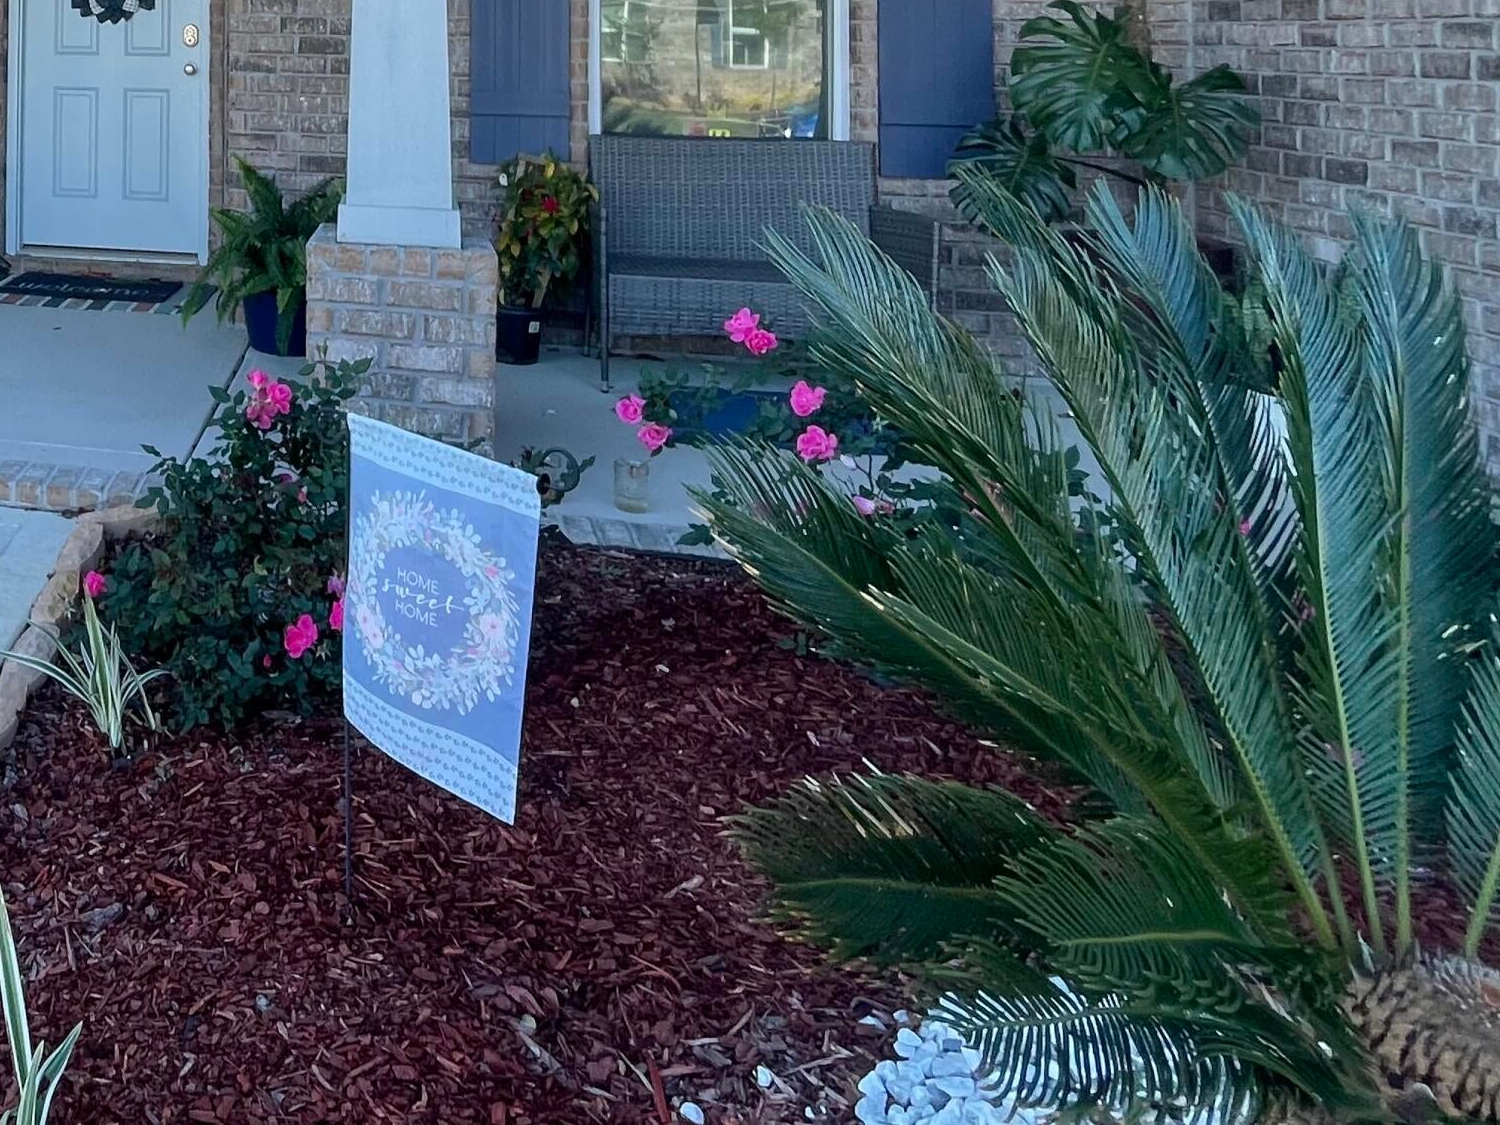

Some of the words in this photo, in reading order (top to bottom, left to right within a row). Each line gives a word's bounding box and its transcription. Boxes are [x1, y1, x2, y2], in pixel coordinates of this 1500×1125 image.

[397, 566, 439, 595] HOME
[381, 578, 465, 614] sweet
[395, 599, 438, 628] HOME
